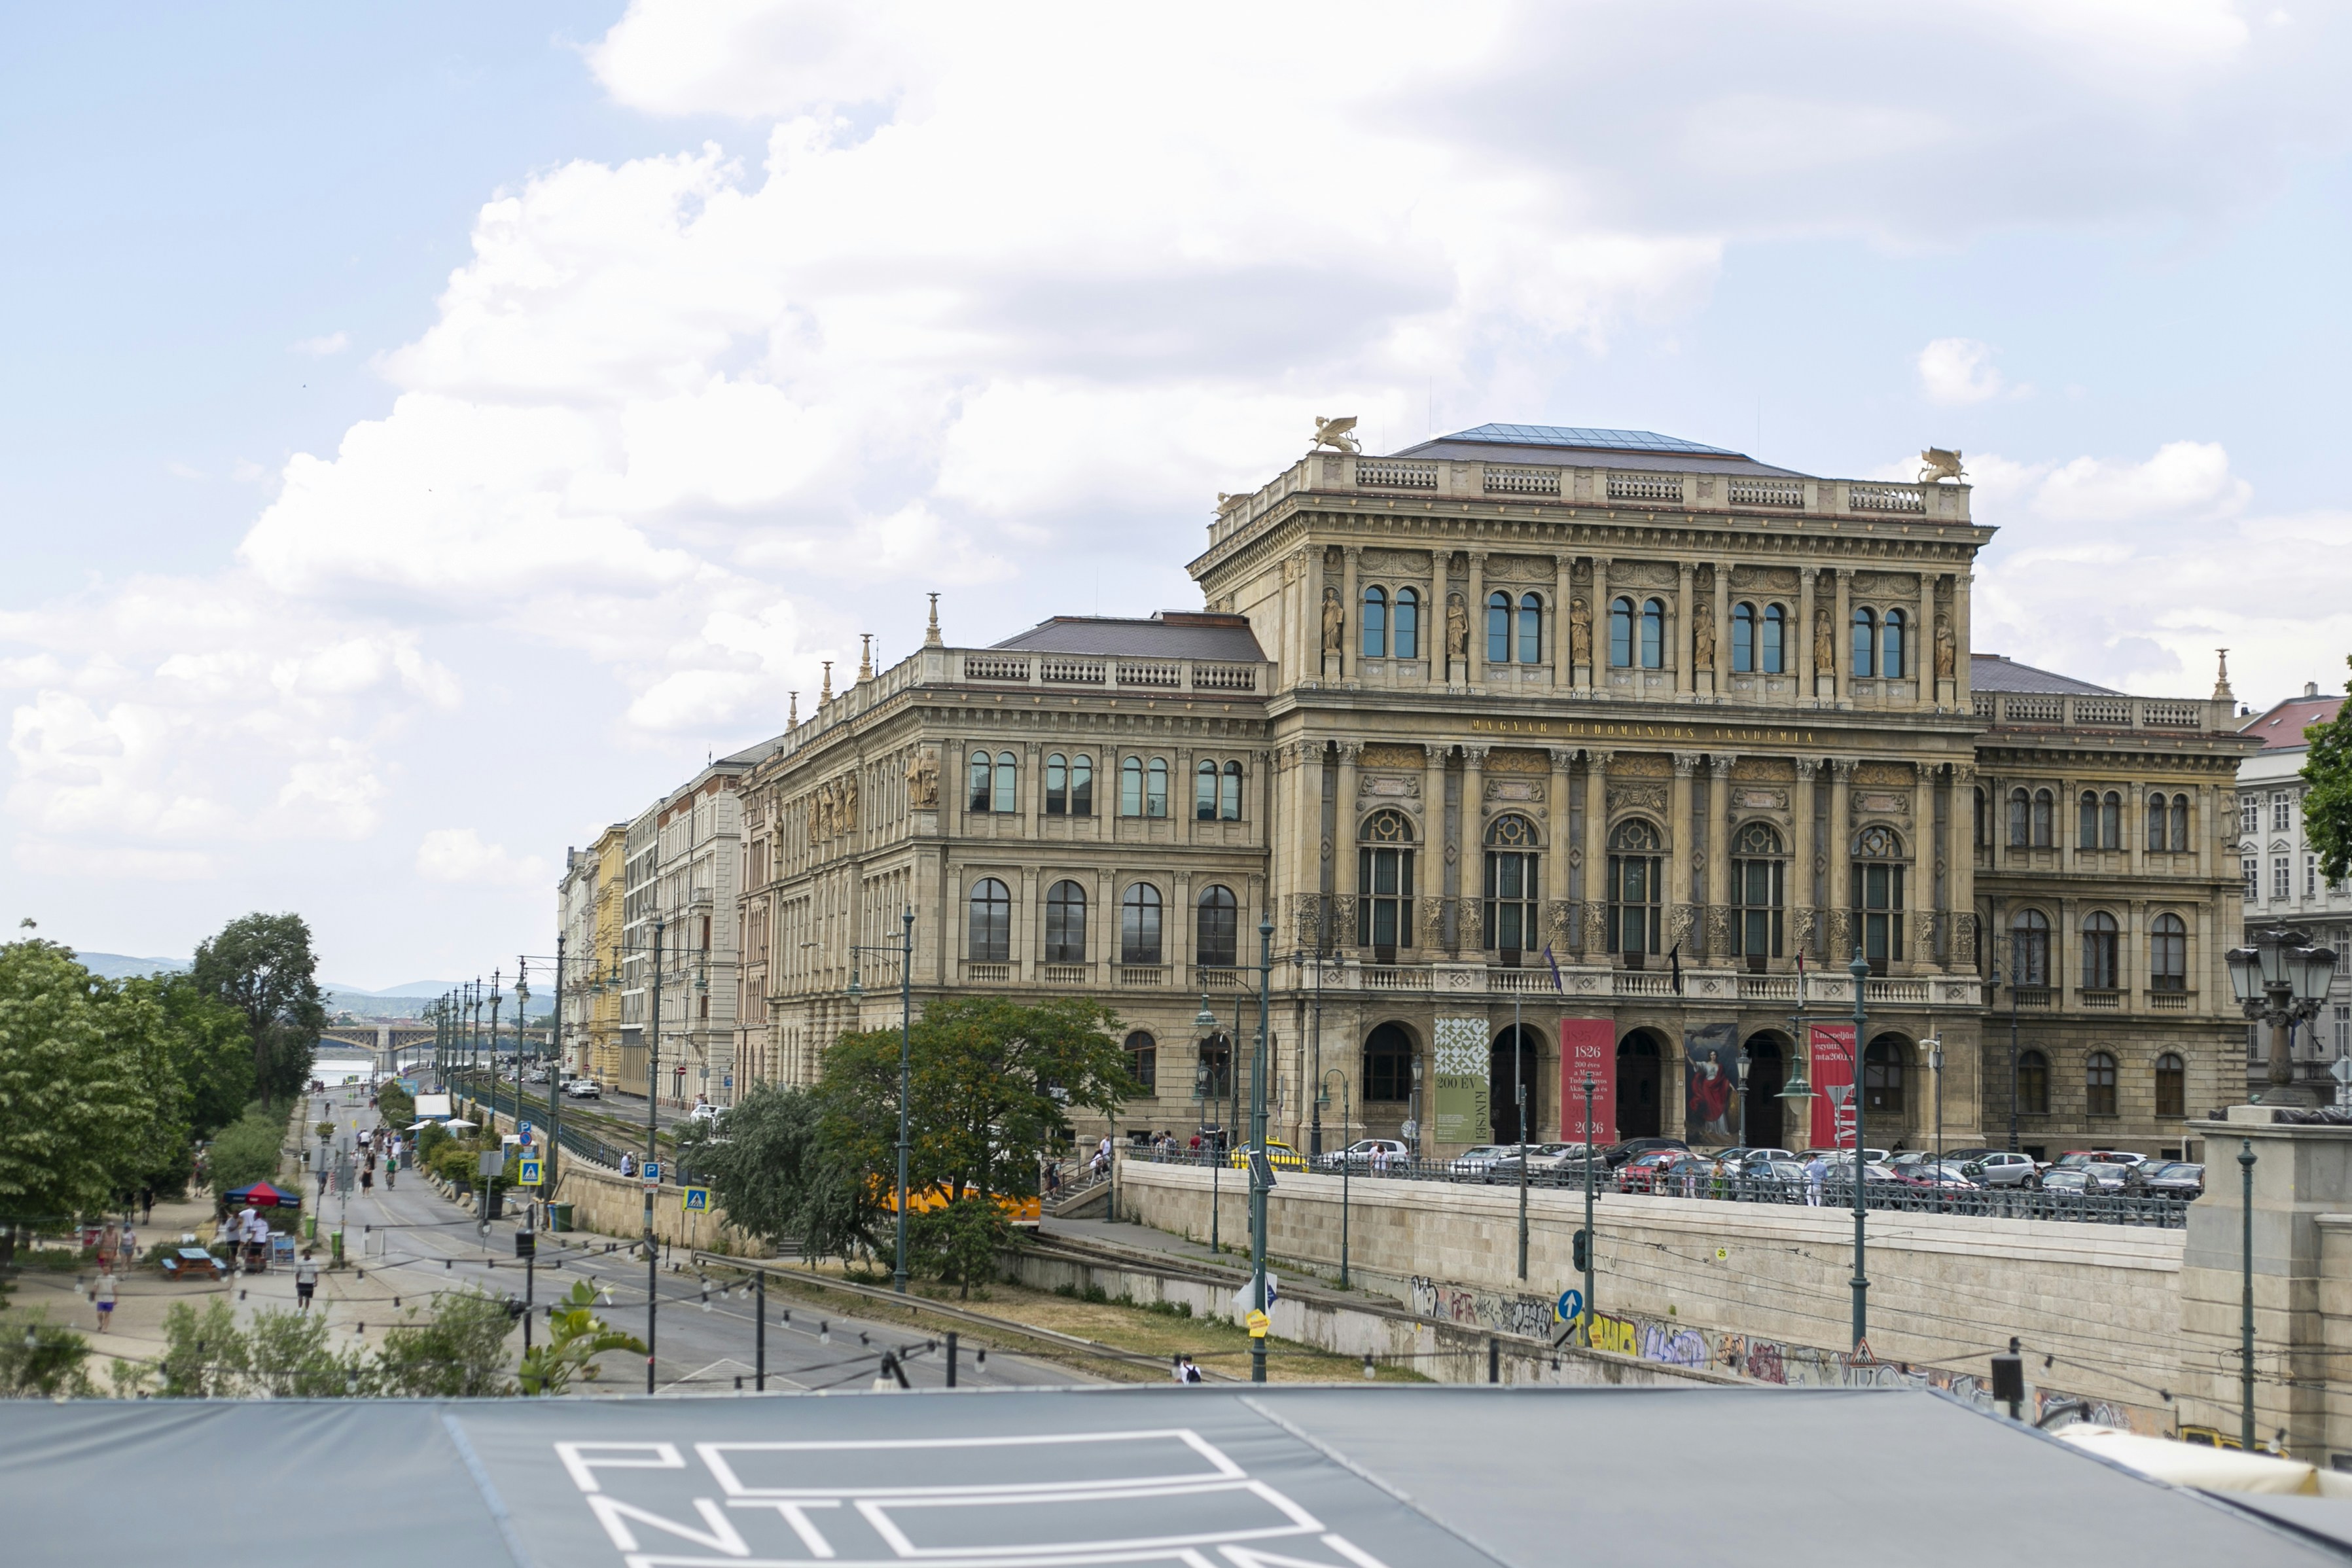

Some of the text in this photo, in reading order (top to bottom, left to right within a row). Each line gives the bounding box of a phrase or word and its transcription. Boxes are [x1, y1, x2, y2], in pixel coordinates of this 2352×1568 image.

[1472, 719, 1812, 743] MAGYAR TUDOMÁNYOS AKADÉMIA
[1575, 1045, 1601, 1058] 1826
[1437, 1075, 1477, 1089] 200 ÉV
[1476, 1091, 1486, 1139] KINCSEI
